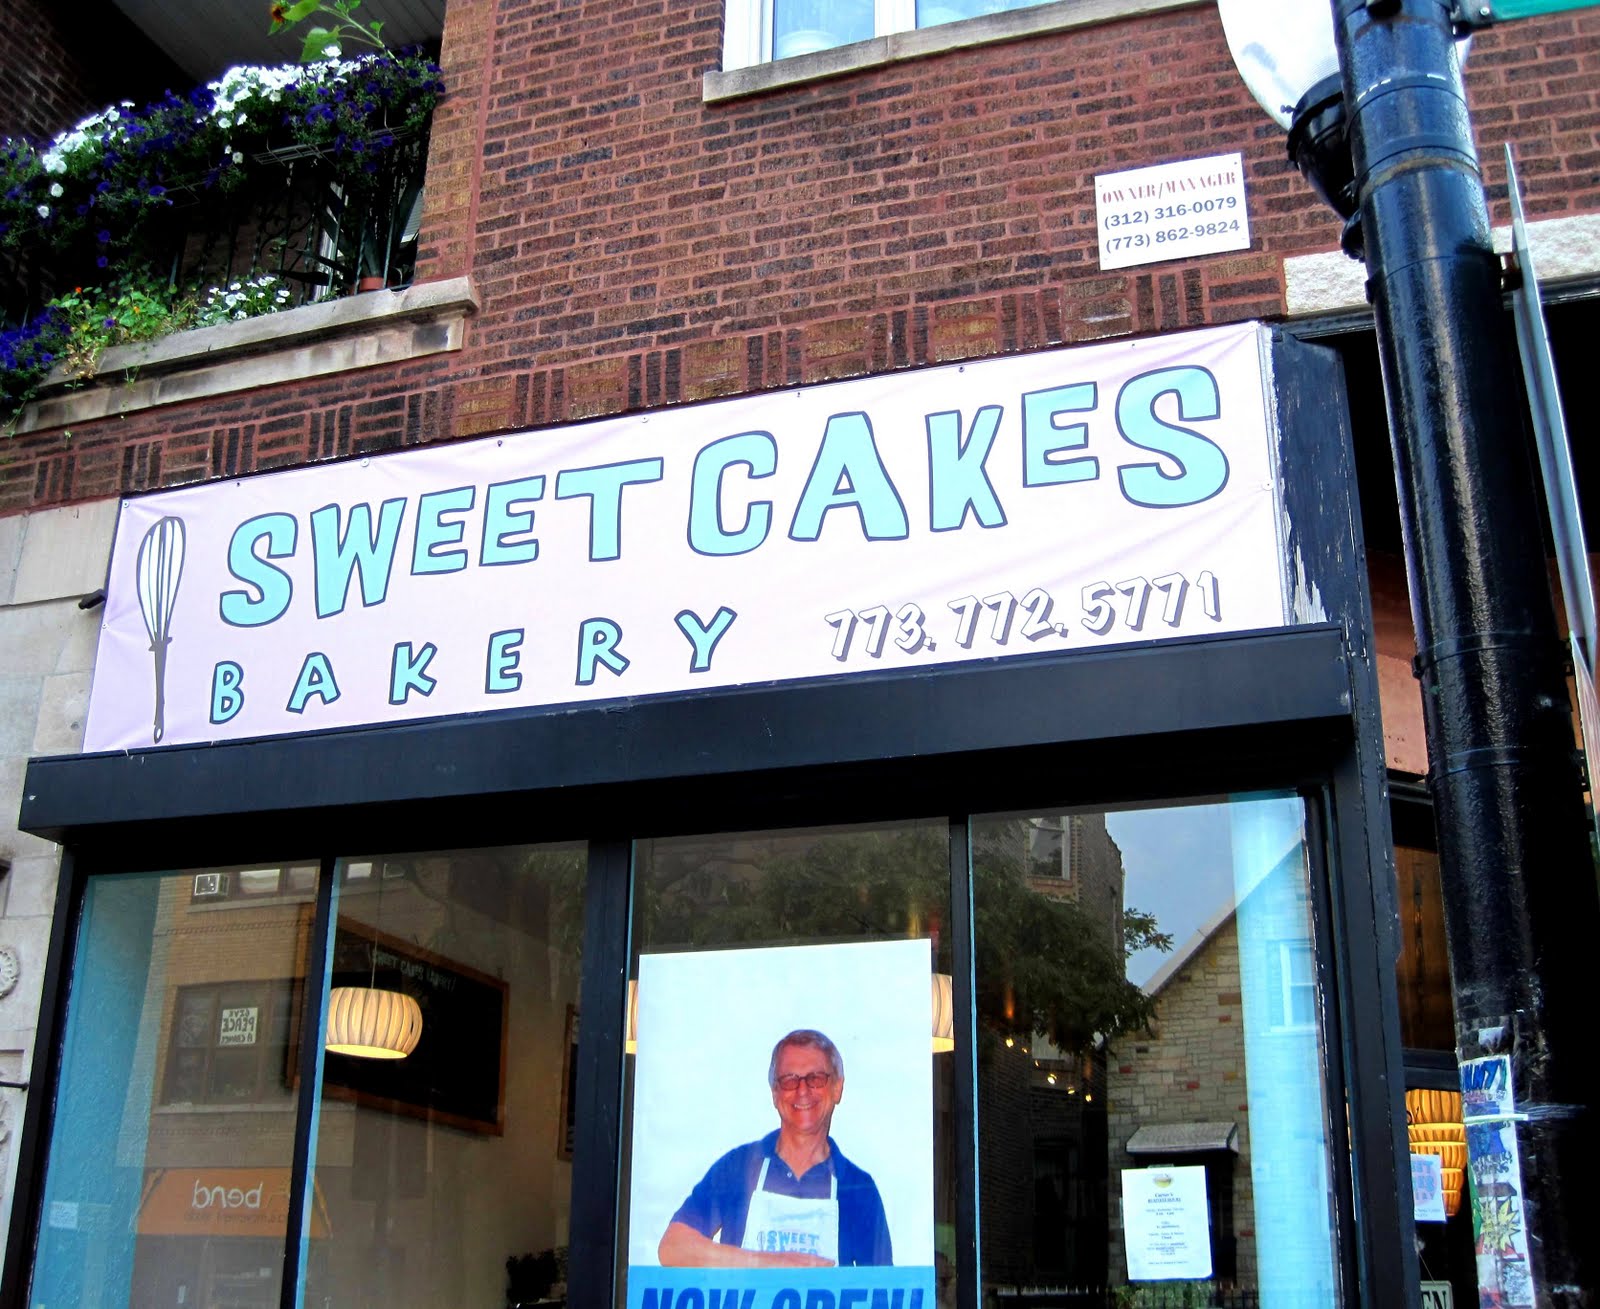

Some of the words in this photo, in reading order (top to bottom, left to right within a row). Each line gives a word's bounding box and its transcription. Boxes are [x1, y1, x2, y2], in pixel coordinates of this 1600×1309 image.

[1102, 171, 1236, 204] OWNER/MANAGER
[1104, 210, 1149, 230] (312)
[1154, 196, 1237, 220] 316-0079
[1105, 234, 1151, 254] (773)
[1155, 219, 1240, 243] 862-9824
[220, 457, 664, 628] SWEET
[687, 365, 1230, 556] CAKES
[209, 606, 738, 724] BAKERY
[767, 1230, 820, 1247] SWEET
